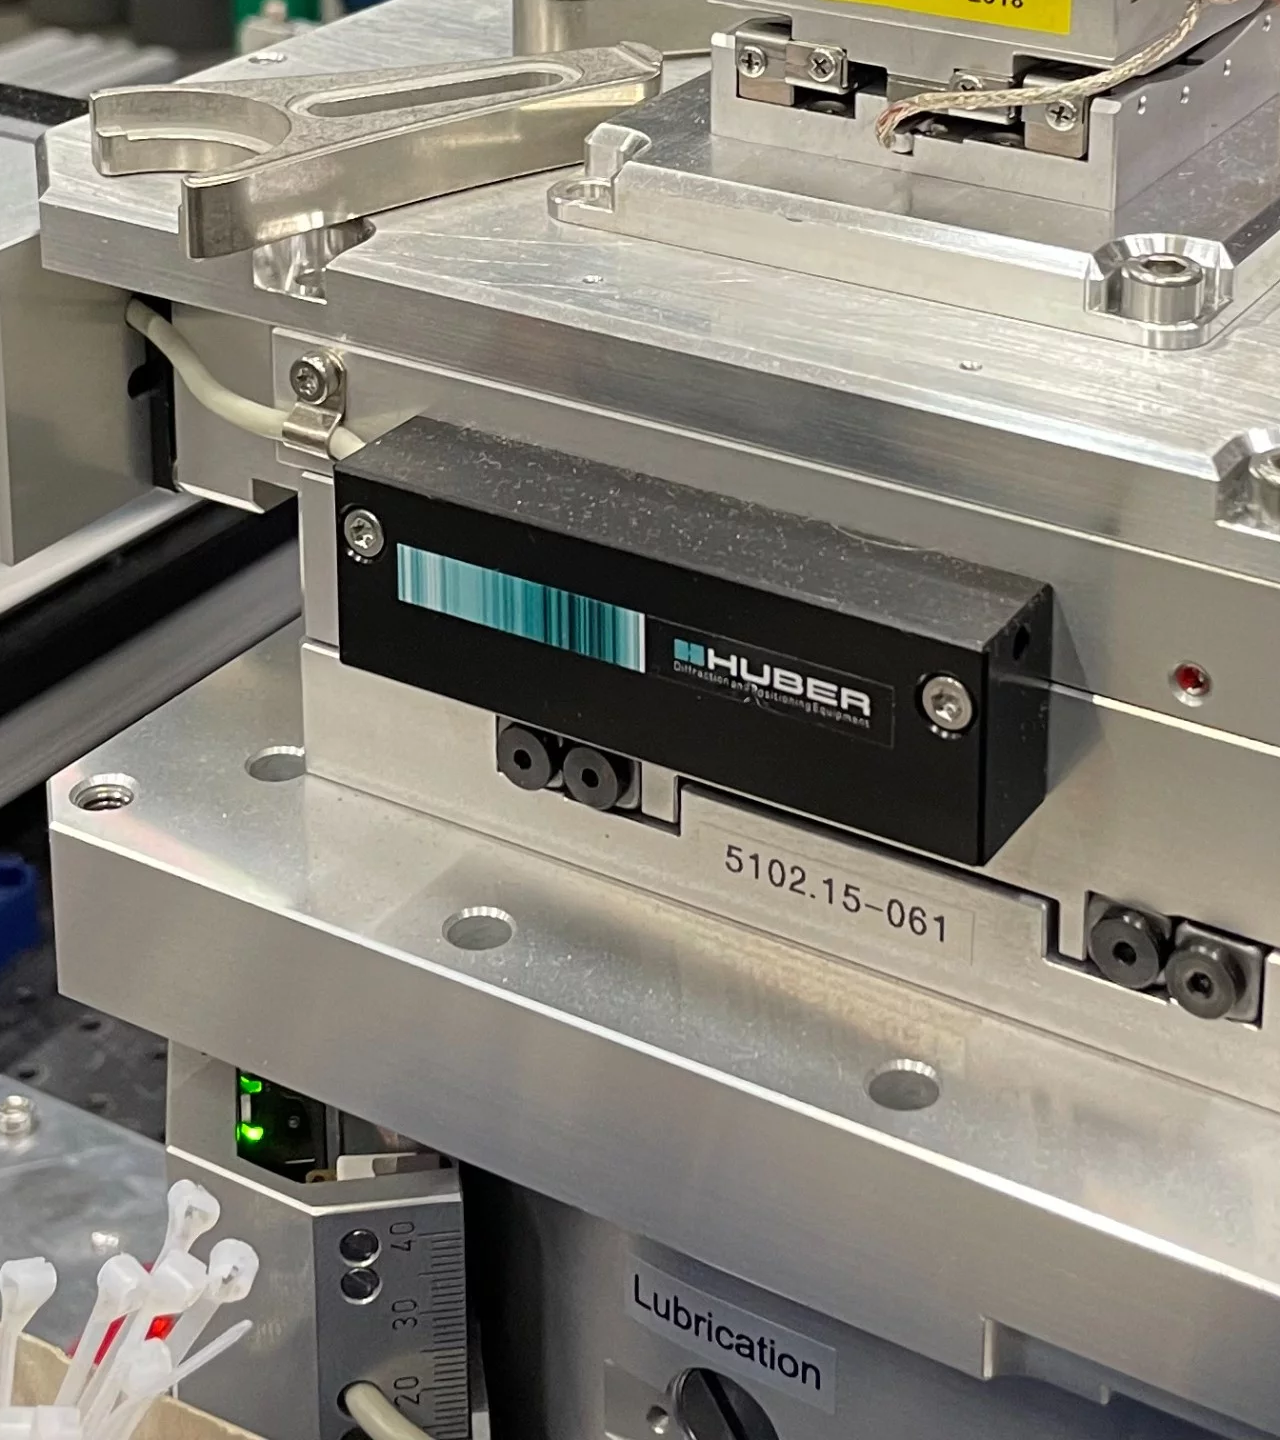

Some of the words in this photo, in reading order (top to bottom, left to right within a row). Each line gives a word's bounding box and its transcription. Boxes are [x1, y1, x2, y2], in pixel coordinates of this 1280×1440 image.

[673, 660, 730, 689] Diffraction
[750, 683, 812, 713] Positioning
[812, 701, 871, 729] Equipment
[706, 647, 872, 717] HUBER
[725, 844, 945, 943] 5102.15-061
[389, 1221, 416, 1252] 40
[391, 1298, 418, 1331] 30
[634, 1273, 821, 1391] Lubrication
[393, 1375, 421, 1407] 20
